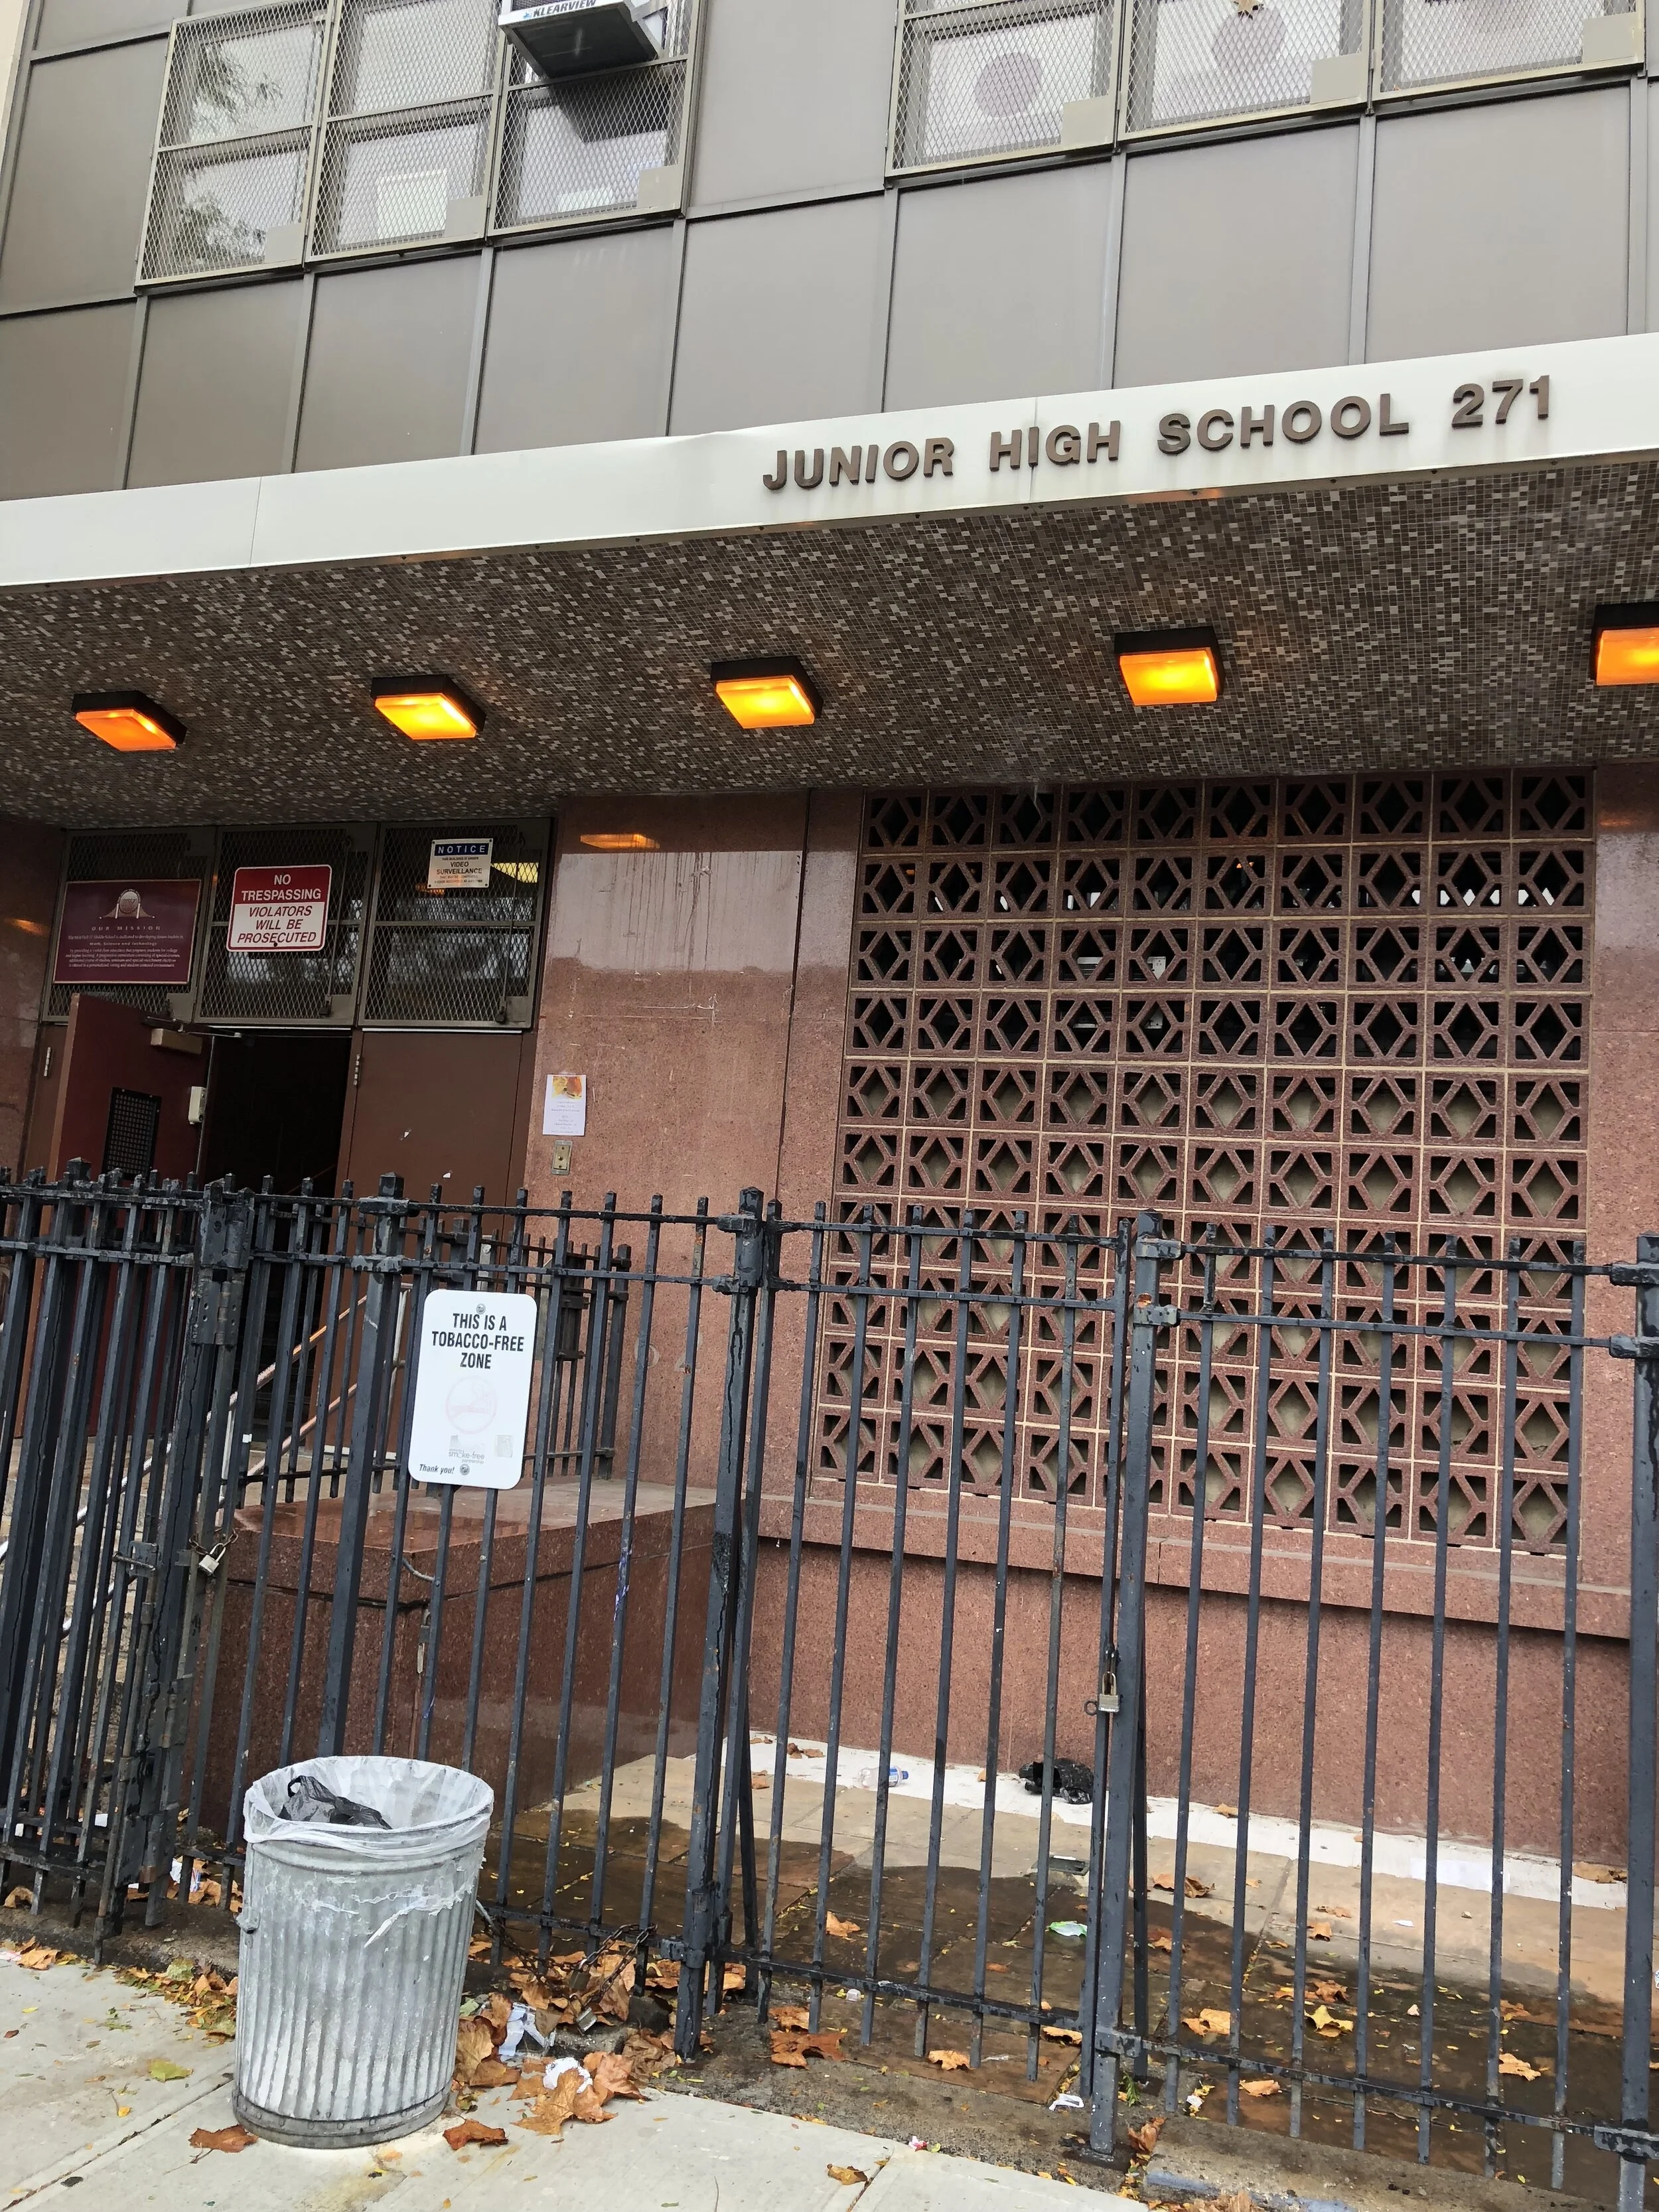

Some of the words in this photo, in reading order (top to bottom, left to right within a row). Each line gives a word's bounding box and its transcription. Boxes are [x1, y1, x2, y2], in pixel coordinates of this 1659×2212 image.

[533, 0, 596, 17] KLEARVIEW
[762, 437, 954, 491] JUNIOR
[989, 419, 1121, 473] HIGH
[1157, 393, 1409, 455] SCHOOL
[1451, 374, 1550, 429] 271
[438, 845, 486, 854] NOTICE
[273, 874, 291, 885] NO
[241, 888, 322, 901] TRESPASSING
[249, 905, 313, 917] VIOLATORS
[255, 919, 281, 930] WILL
[286, 919, 303, 930] BE
[237, 932, 317, 943] PROSECUTED
[453, 1313, 480, 1330] THIS
[484, 1314, 496, 1331] IS
[499, 1316, 507, 1331] A
[431, 1331, 525, 1352] TOBACCO-FREE
[460, 1352, 492, 1369] ZONE
[449, 1449, 485, 1459] smoke-free
[419, 1464, 439, 1473] Thank
[440, 1466, 455, 1475] you!
